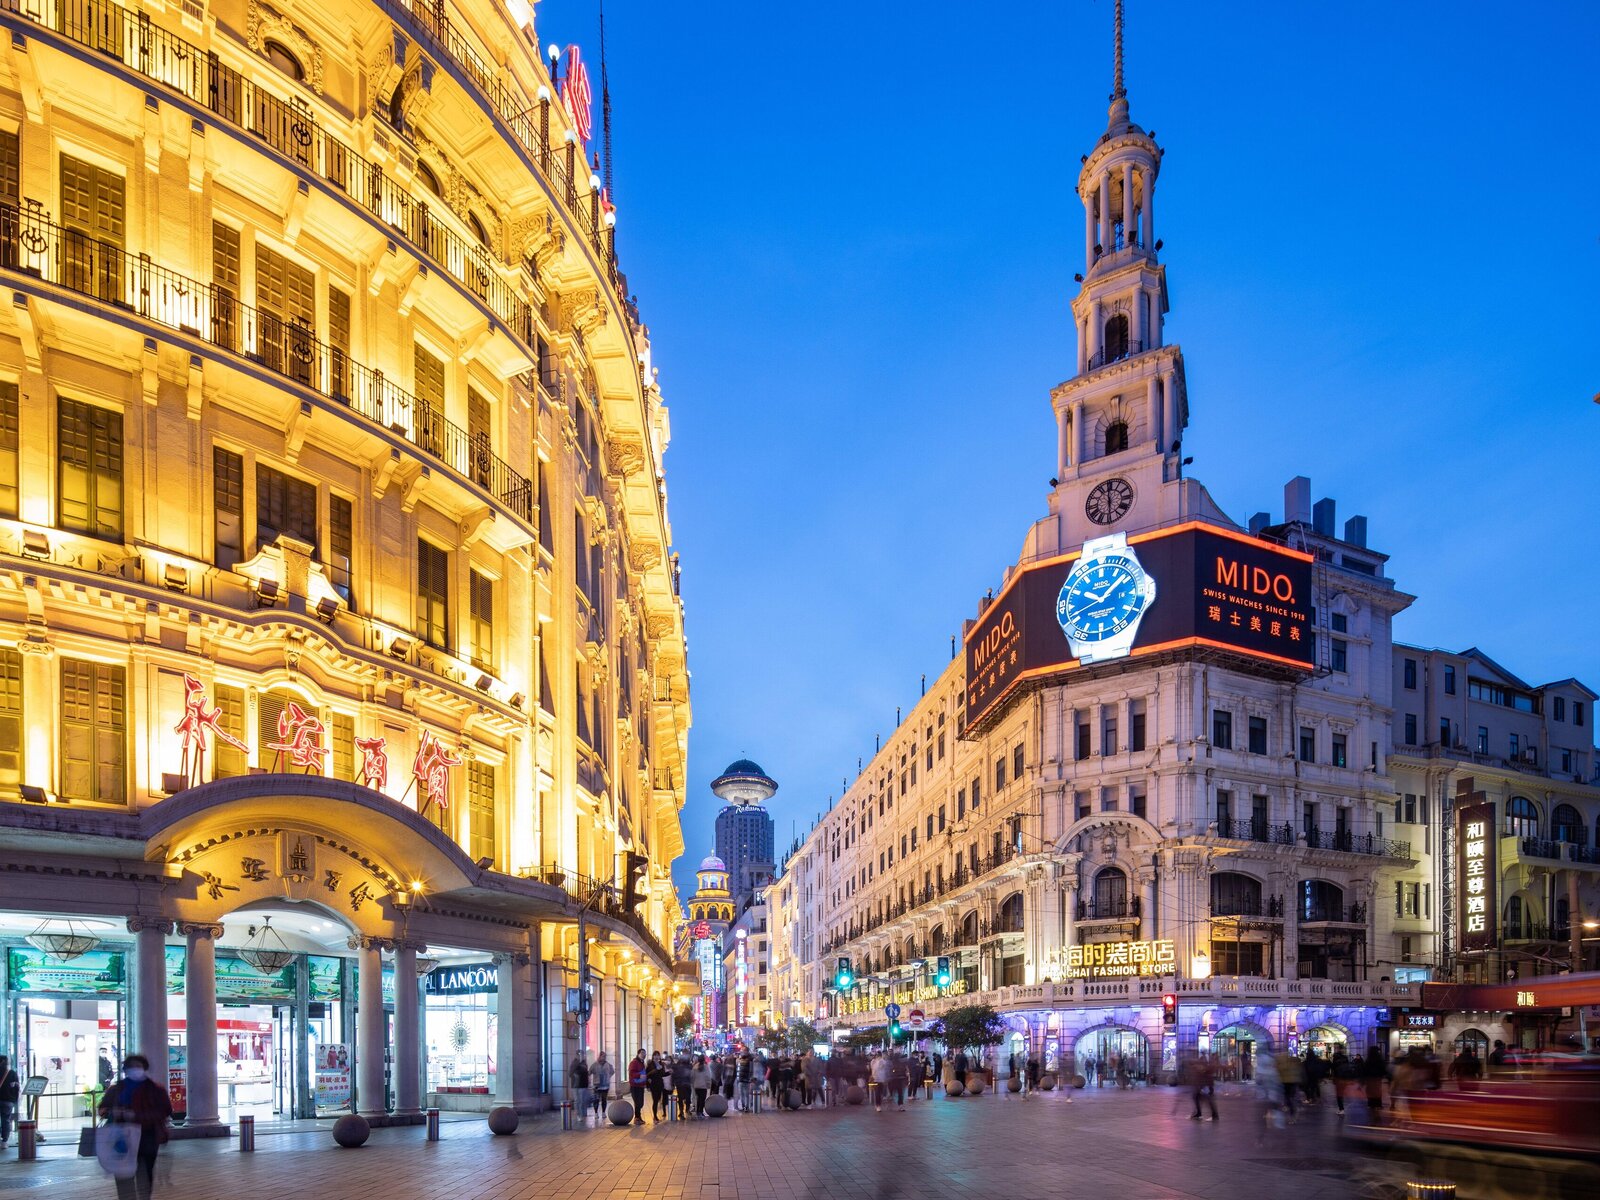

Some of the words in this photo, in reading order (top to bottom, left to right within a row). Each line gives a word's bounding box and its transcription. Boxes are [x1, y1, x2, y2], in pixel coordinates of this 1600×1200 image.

[1058, 599, 1066, 614] 45
[1203, 588, 1227, 600] SWISS
[1229, 595, 1263, 610] WATCHES
[1265, 604, 1288, 617] SINCE
[1290, 611, 1305, 621] 1918
[1073, 630, 1089, 641] 35
[1208, 605, 1301, 641] 瑞士美度表
[1466, 821, 1486, 933] 和颐至尊酒店
[1045, 939, 1175, 967] 上海时装商店
[440, 967, 498, 989] LANCÔM
[1094, 965, 1137, 976] FASHION
[1141, 963, 1176, 974] STORE
